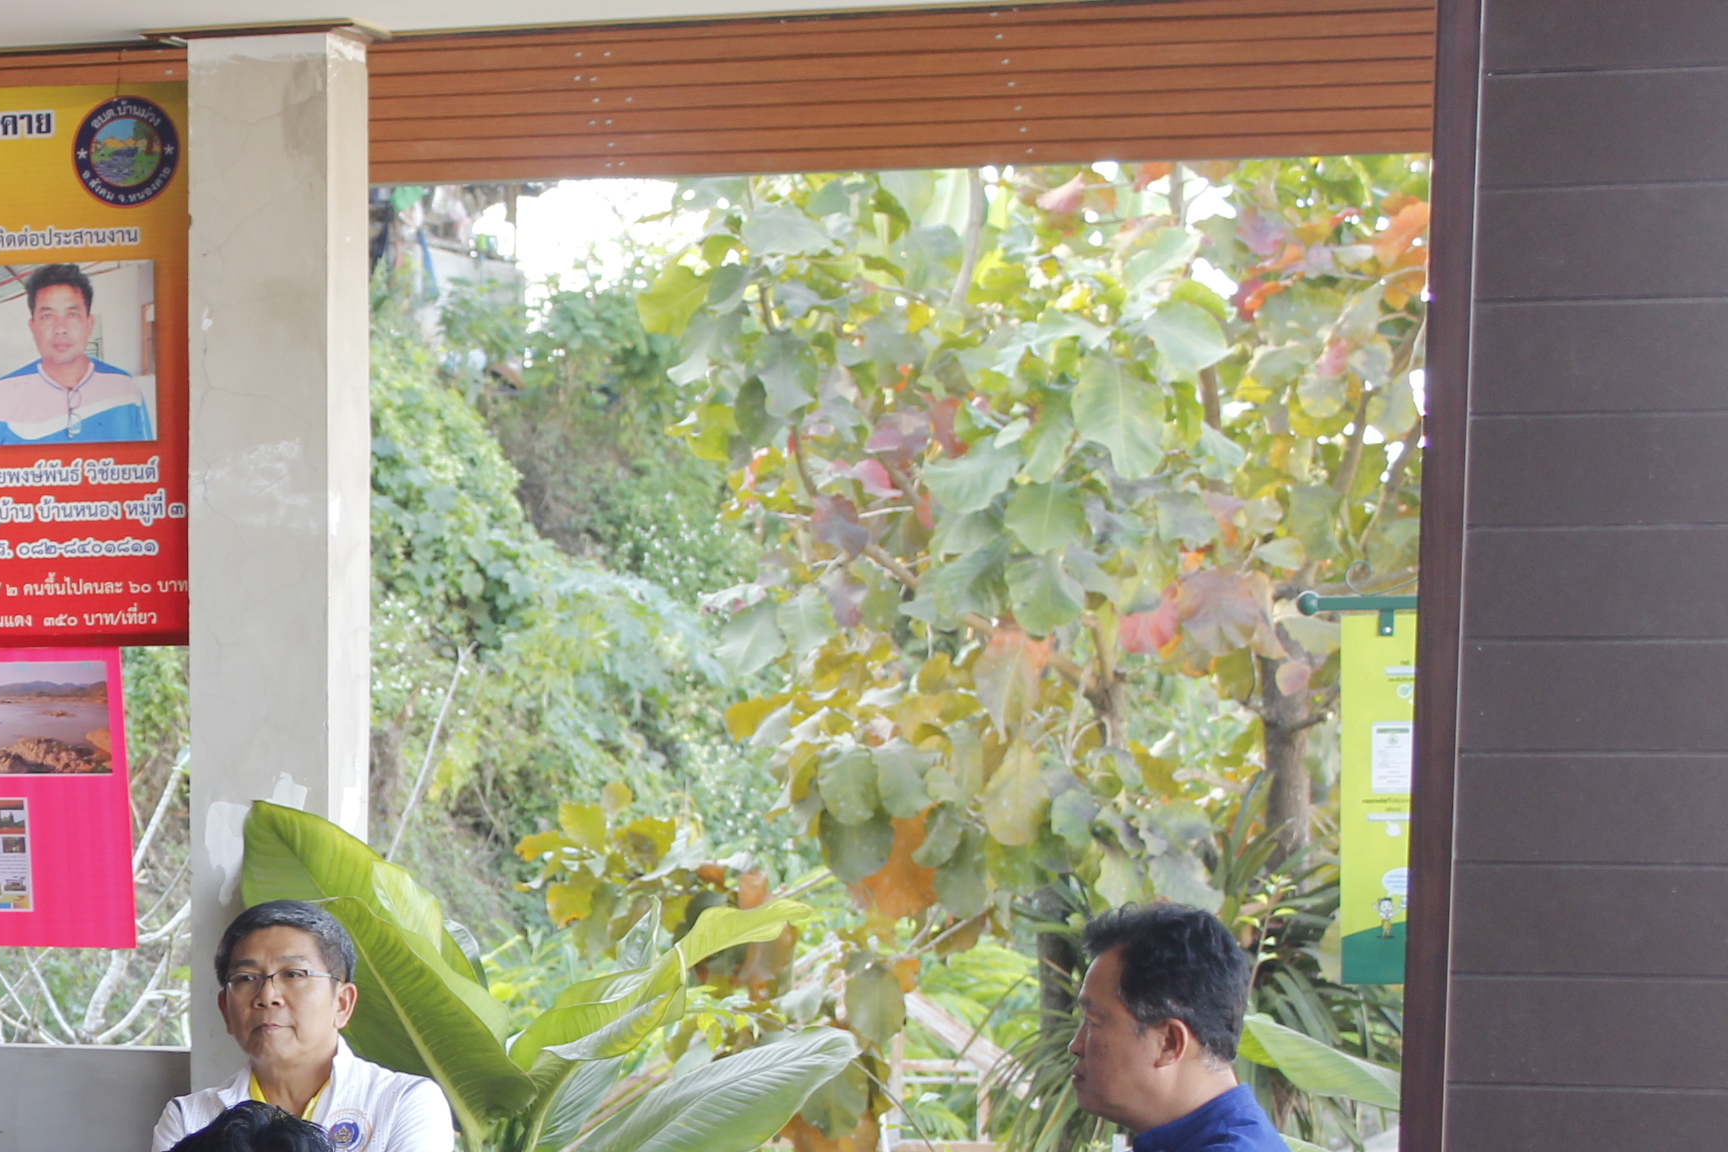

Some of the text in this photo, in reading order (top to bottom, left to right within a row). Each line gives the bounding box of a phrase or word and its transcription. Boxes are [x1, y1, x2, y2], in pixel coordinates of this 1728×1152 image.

[86, 457, 157, 482] วิชัยยนต์
[38, 497, 119, 519] บ้านหนอง
[125, 492, 164, 524] หมู่ที่
[170, 505, 184, 517] ๓
[23, 572, 122, 596] คนขึ้นไปคนละ
